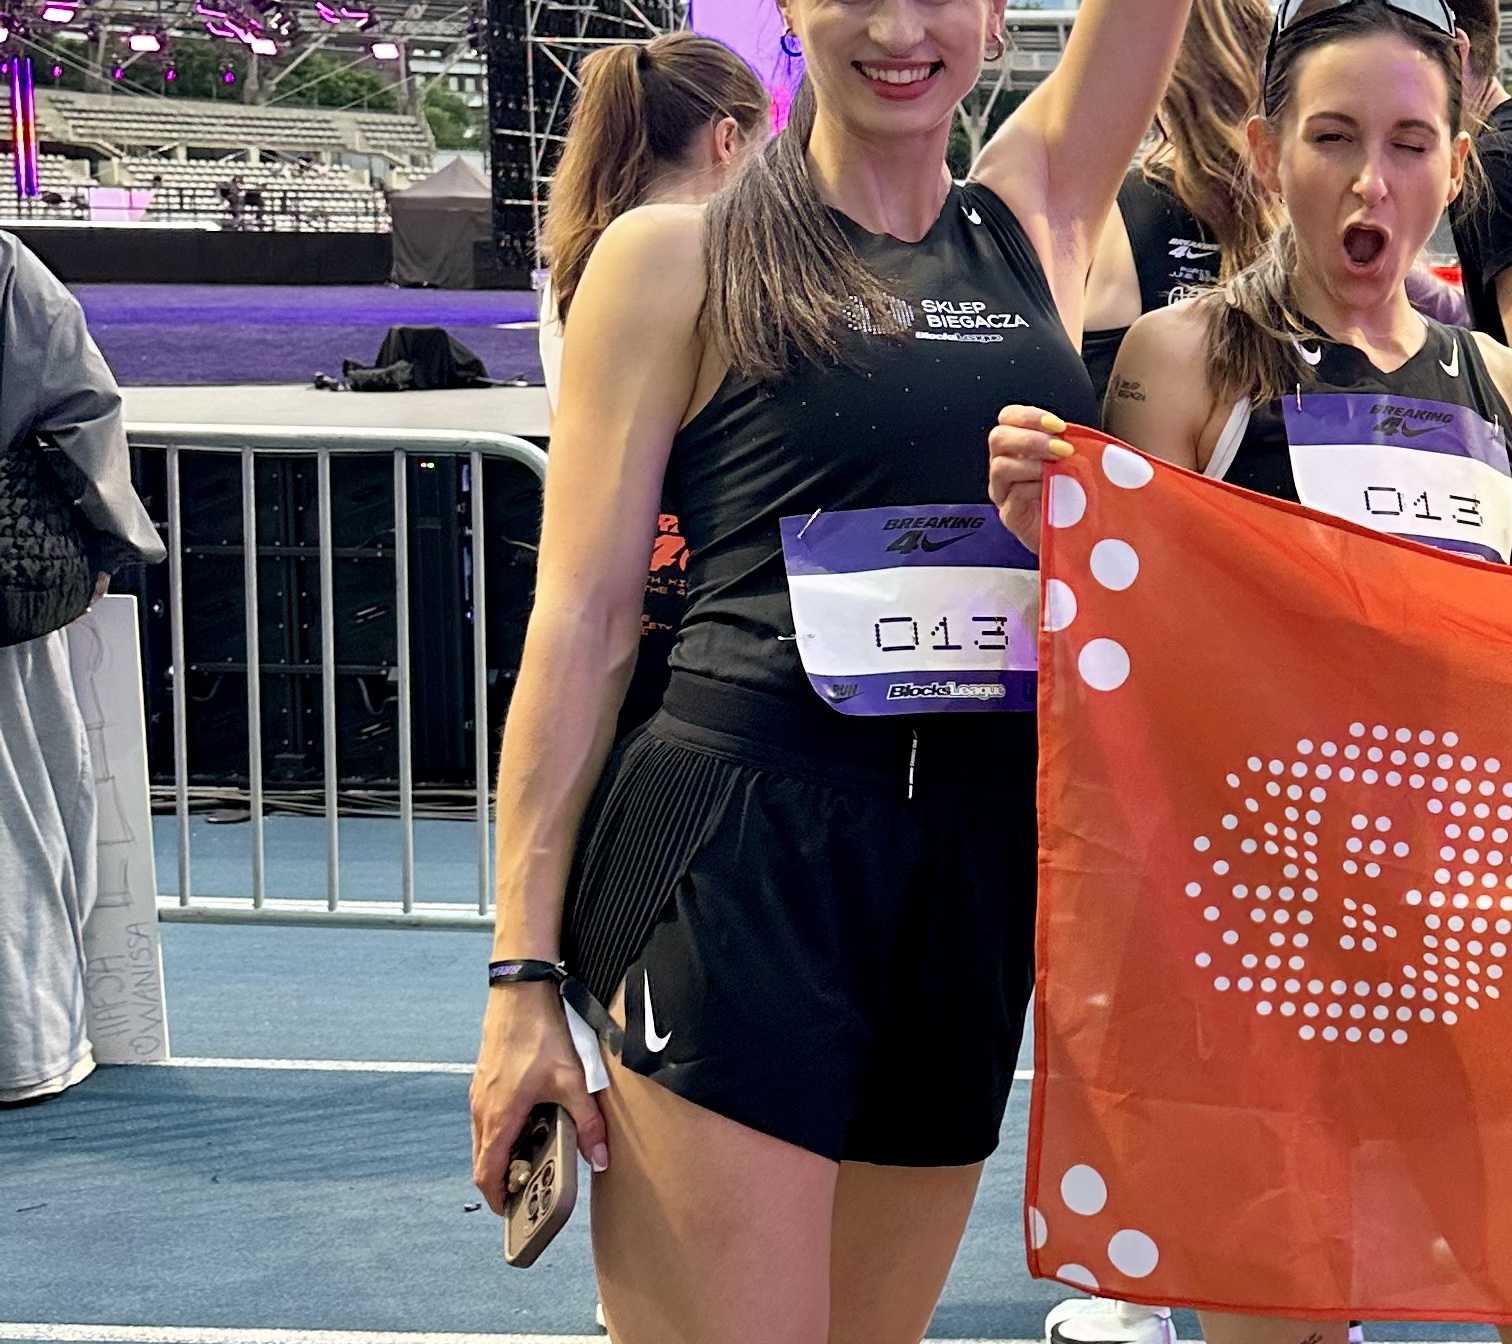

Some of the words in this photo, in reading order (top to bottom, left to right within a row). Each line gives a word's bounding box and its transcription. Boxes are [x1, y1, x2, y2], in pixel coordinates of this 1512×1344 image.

[921, 299, 987, 314] SKLEP
[926, 314, 1030, 329] BIEGACZA
[1369, 405, 1454, 423] BREAKING
[1372, 417, 1403, 436] 4
[1363, 486, 1483, 528] 013
[882, 516, 986, 531] BREAKING
[885, 530, 924, 555] 4
[874, 616, 1010, 652] 013
[887, 681, 1007, 701] BlocksLeague
